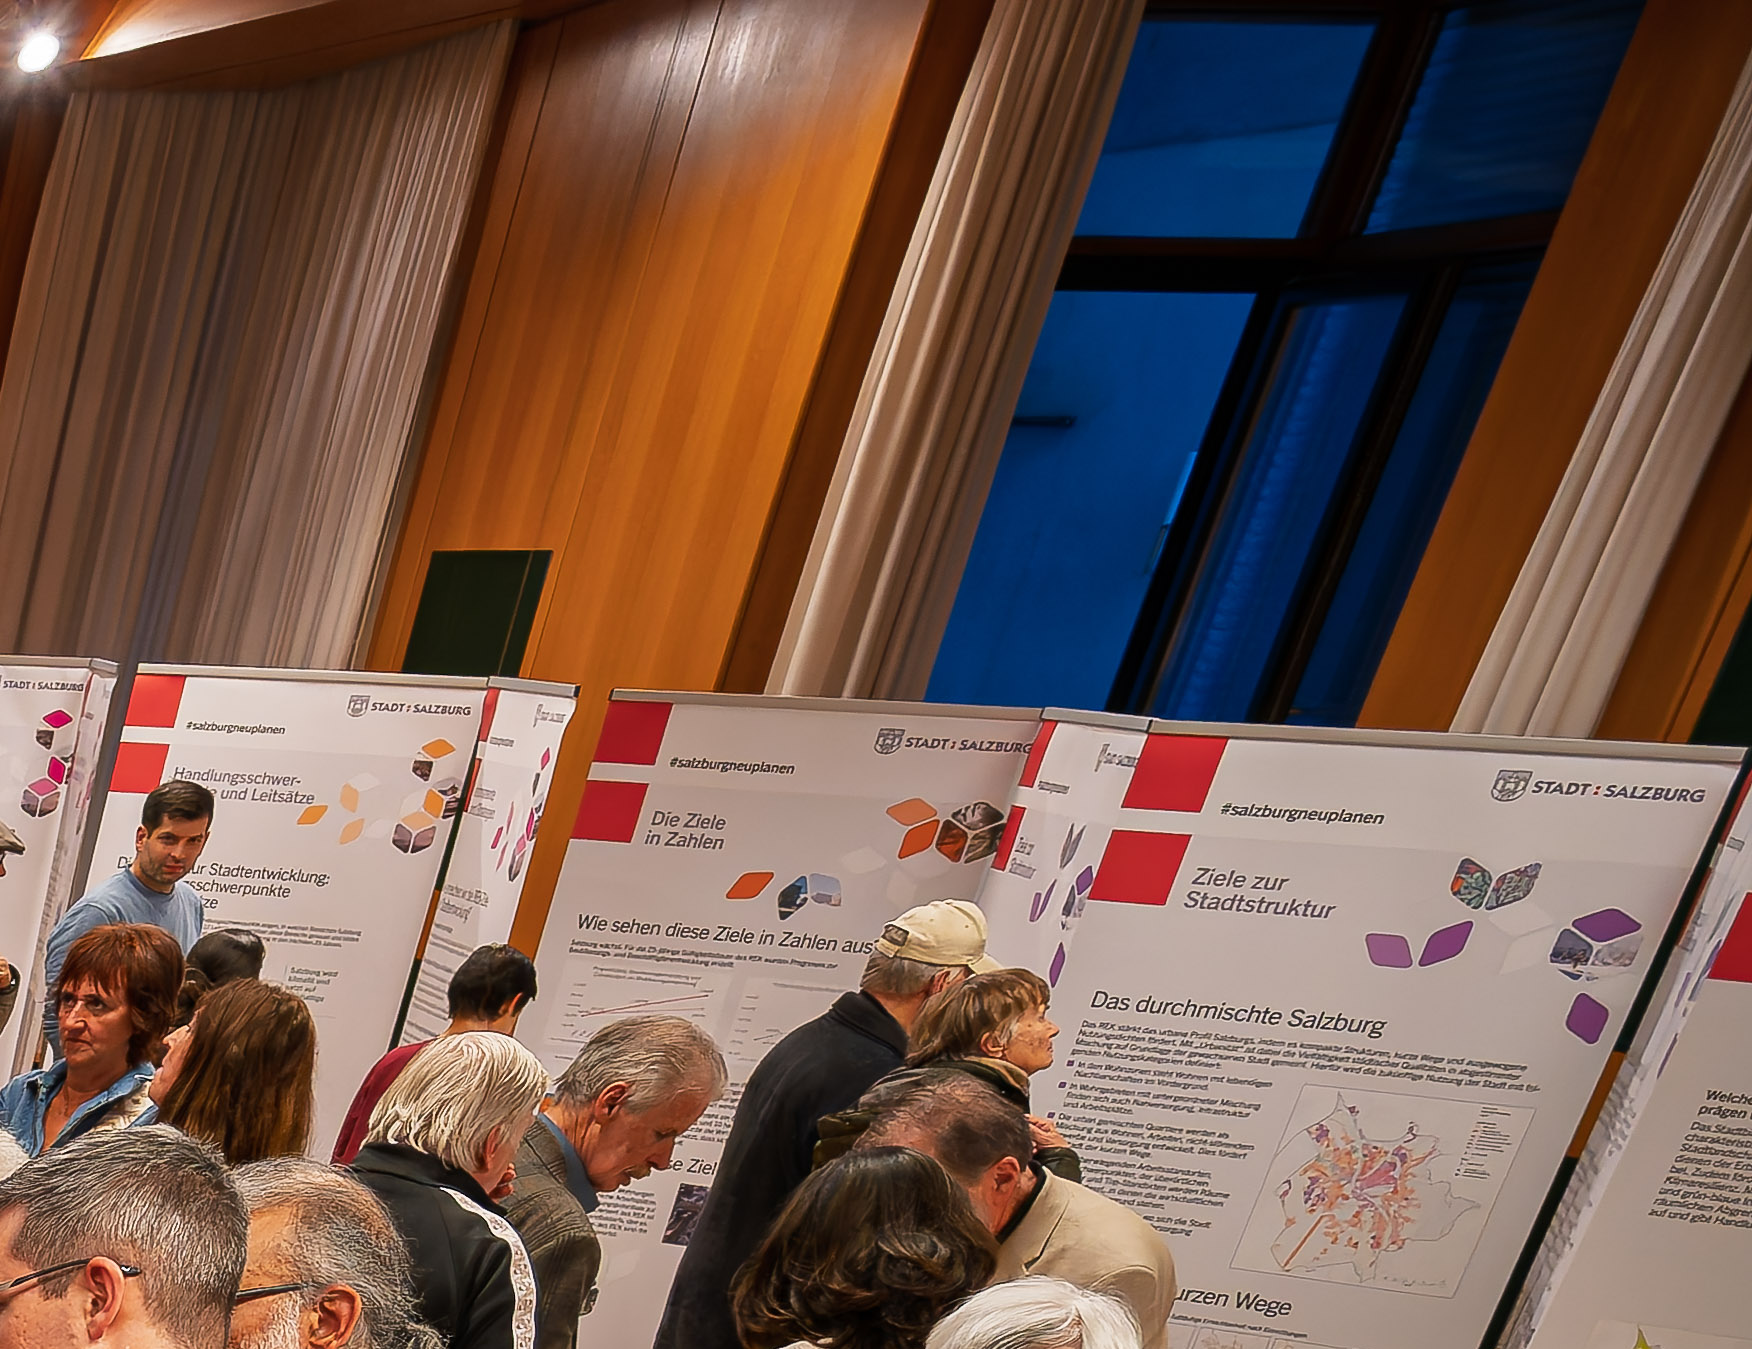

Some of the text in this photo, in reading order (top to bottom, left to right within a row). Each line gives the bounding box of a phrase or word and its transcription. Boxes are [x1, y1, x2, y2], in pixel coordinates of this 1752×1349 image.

[3, 680, 84, 692] STADT SALZBURG
[371, 701, 472, 716] STADT SALZBURG
[186, 721, 285, 735] #salzburgneuplanen
[904, 736, 1033, 754] STADT SALZBURG
[173, 766, 301, 788] Handlungsschwer-
[669, 757, 795, 776] #salzburgneuplanen
[221, 787, 246, 801] und
[251, 787, 315, 804] Leitsätze
[1531, 780, 1706, 803] STADT SALZBURG
[650, 810, 726, 831] Die Ziele
[1220, 802, 1385, 825] #salzburgneuplanen
[644, 830, 725, 851] in Zahlen
[210, 863, 330, 886] Stadtentwicklung:
[1192, 867, 1289, 892] Ziele zur
[1184, 891, 1336, 920] Stadtstruktur
[578, 913, 608, 933] Wie
[612, 917, 660, 937] sehen
[666, 921, 709, 941] diese
[713, 926, 755, 945] Ziele
[759, 928, 774, 946] in
[778, 930, 837, 952] Zahlen
[1091, 990, 1387, 1039] Das durchmischte Salzburg
[1698, 1105, 1747, 1119] prägen
[1235, 1291, 1292, 1317] Wege
